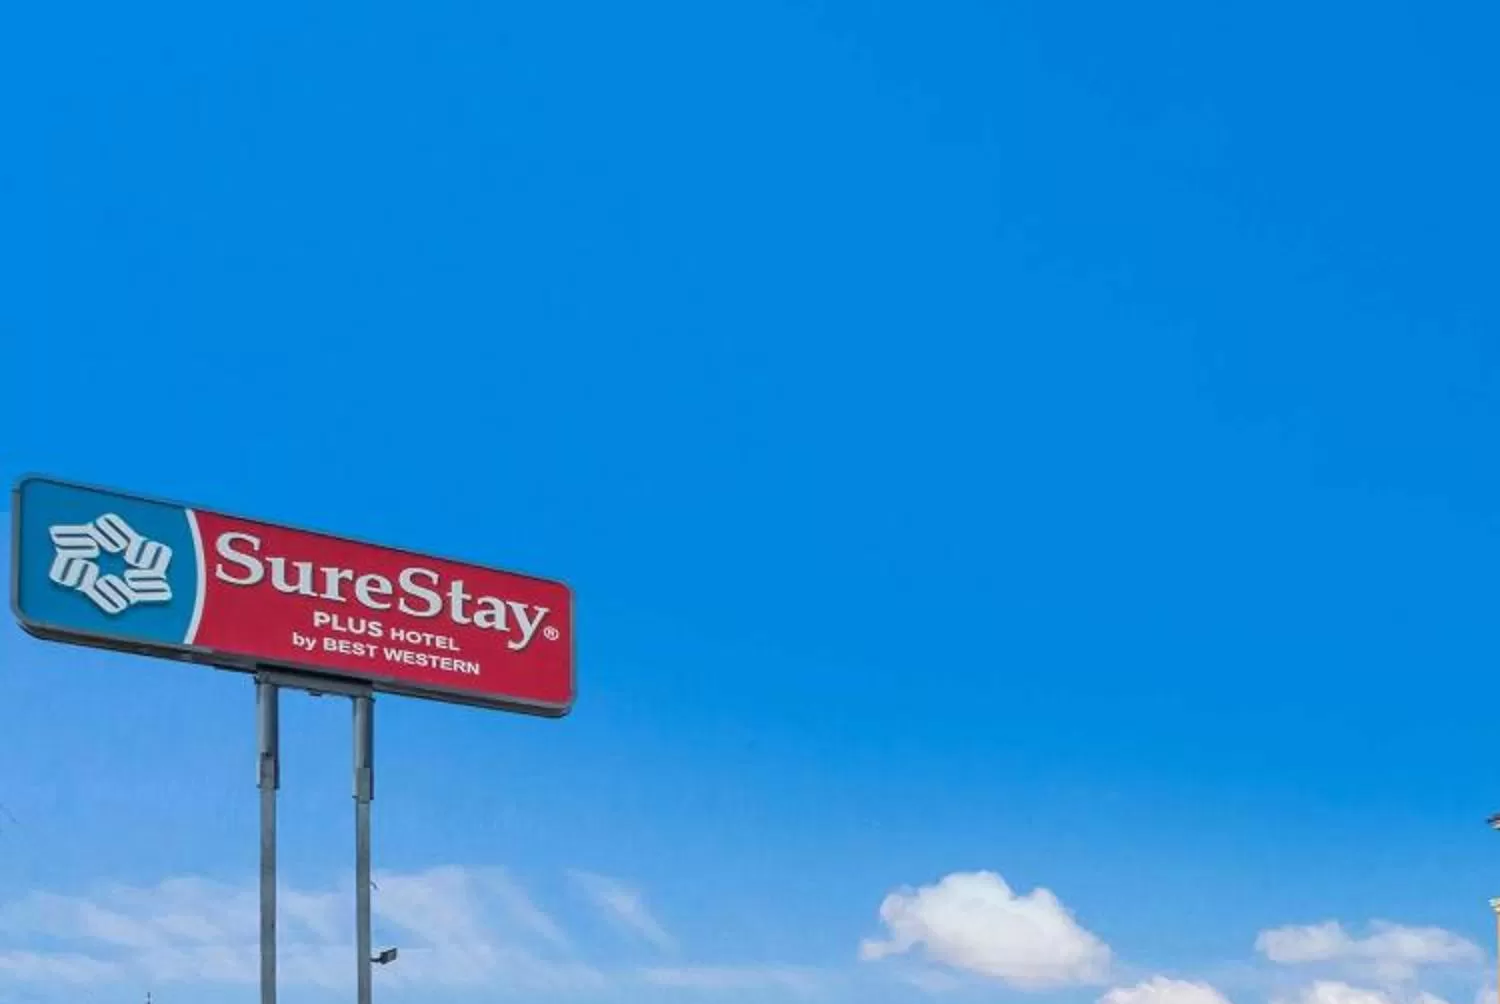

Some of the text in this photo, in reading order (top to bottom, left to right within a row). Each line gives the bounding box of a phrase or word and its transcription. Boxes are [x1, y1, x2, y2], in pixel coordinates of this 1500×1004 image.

[313, 610, 461, 652] PLUS HOTEL
[292, 631, 481, 676] by BEST WESTERN
